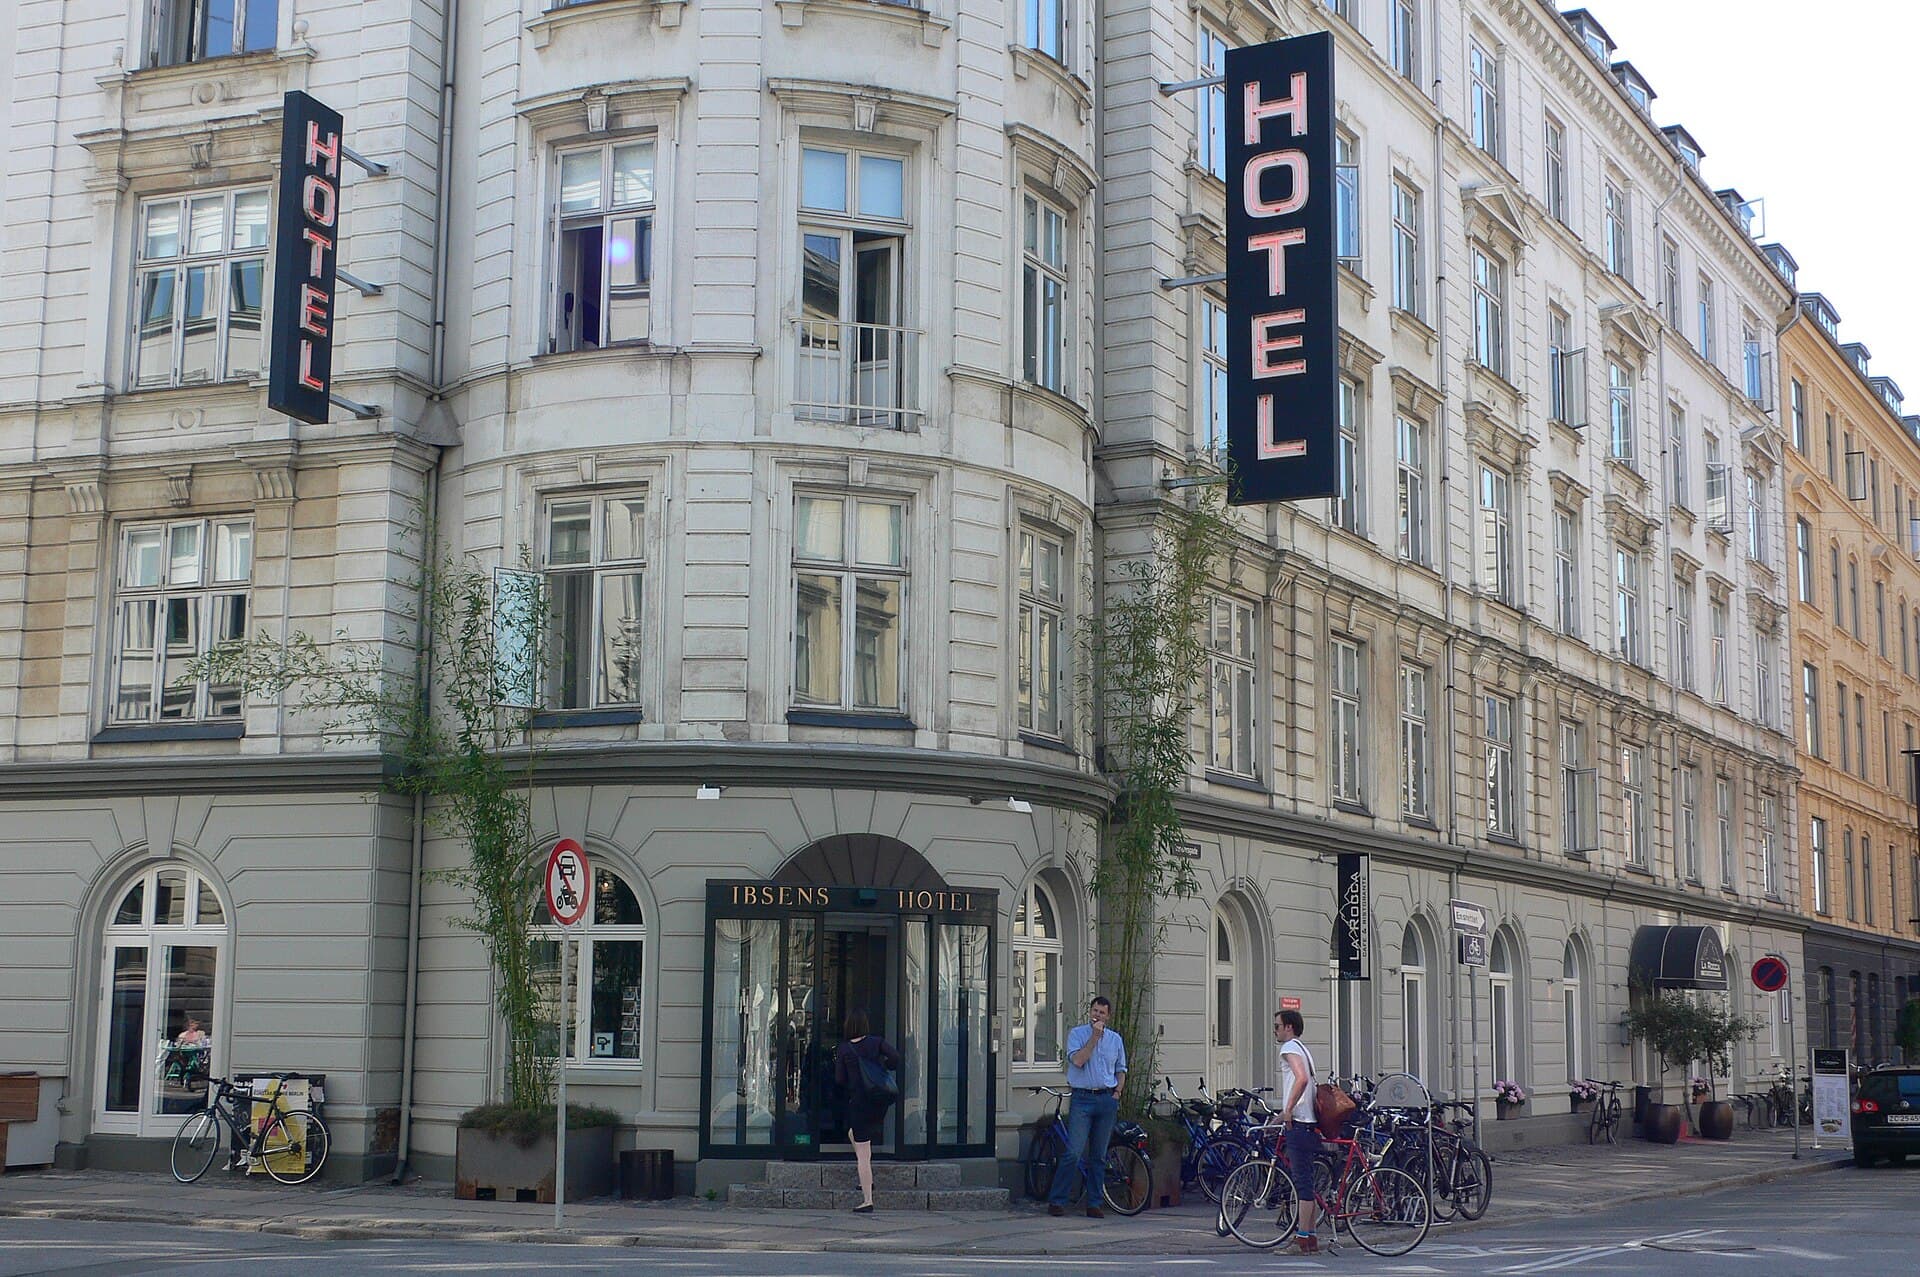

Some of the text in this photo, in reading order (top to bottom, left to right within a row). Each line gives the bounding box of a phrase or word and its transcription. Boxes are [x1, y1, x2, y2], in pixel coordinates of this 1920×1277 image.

[299, 120, 338, 393] HOTEL
[1243, 71, 1310, 460] HOTEL
[732, 886, 977, 911] IBSENS HOTEL
